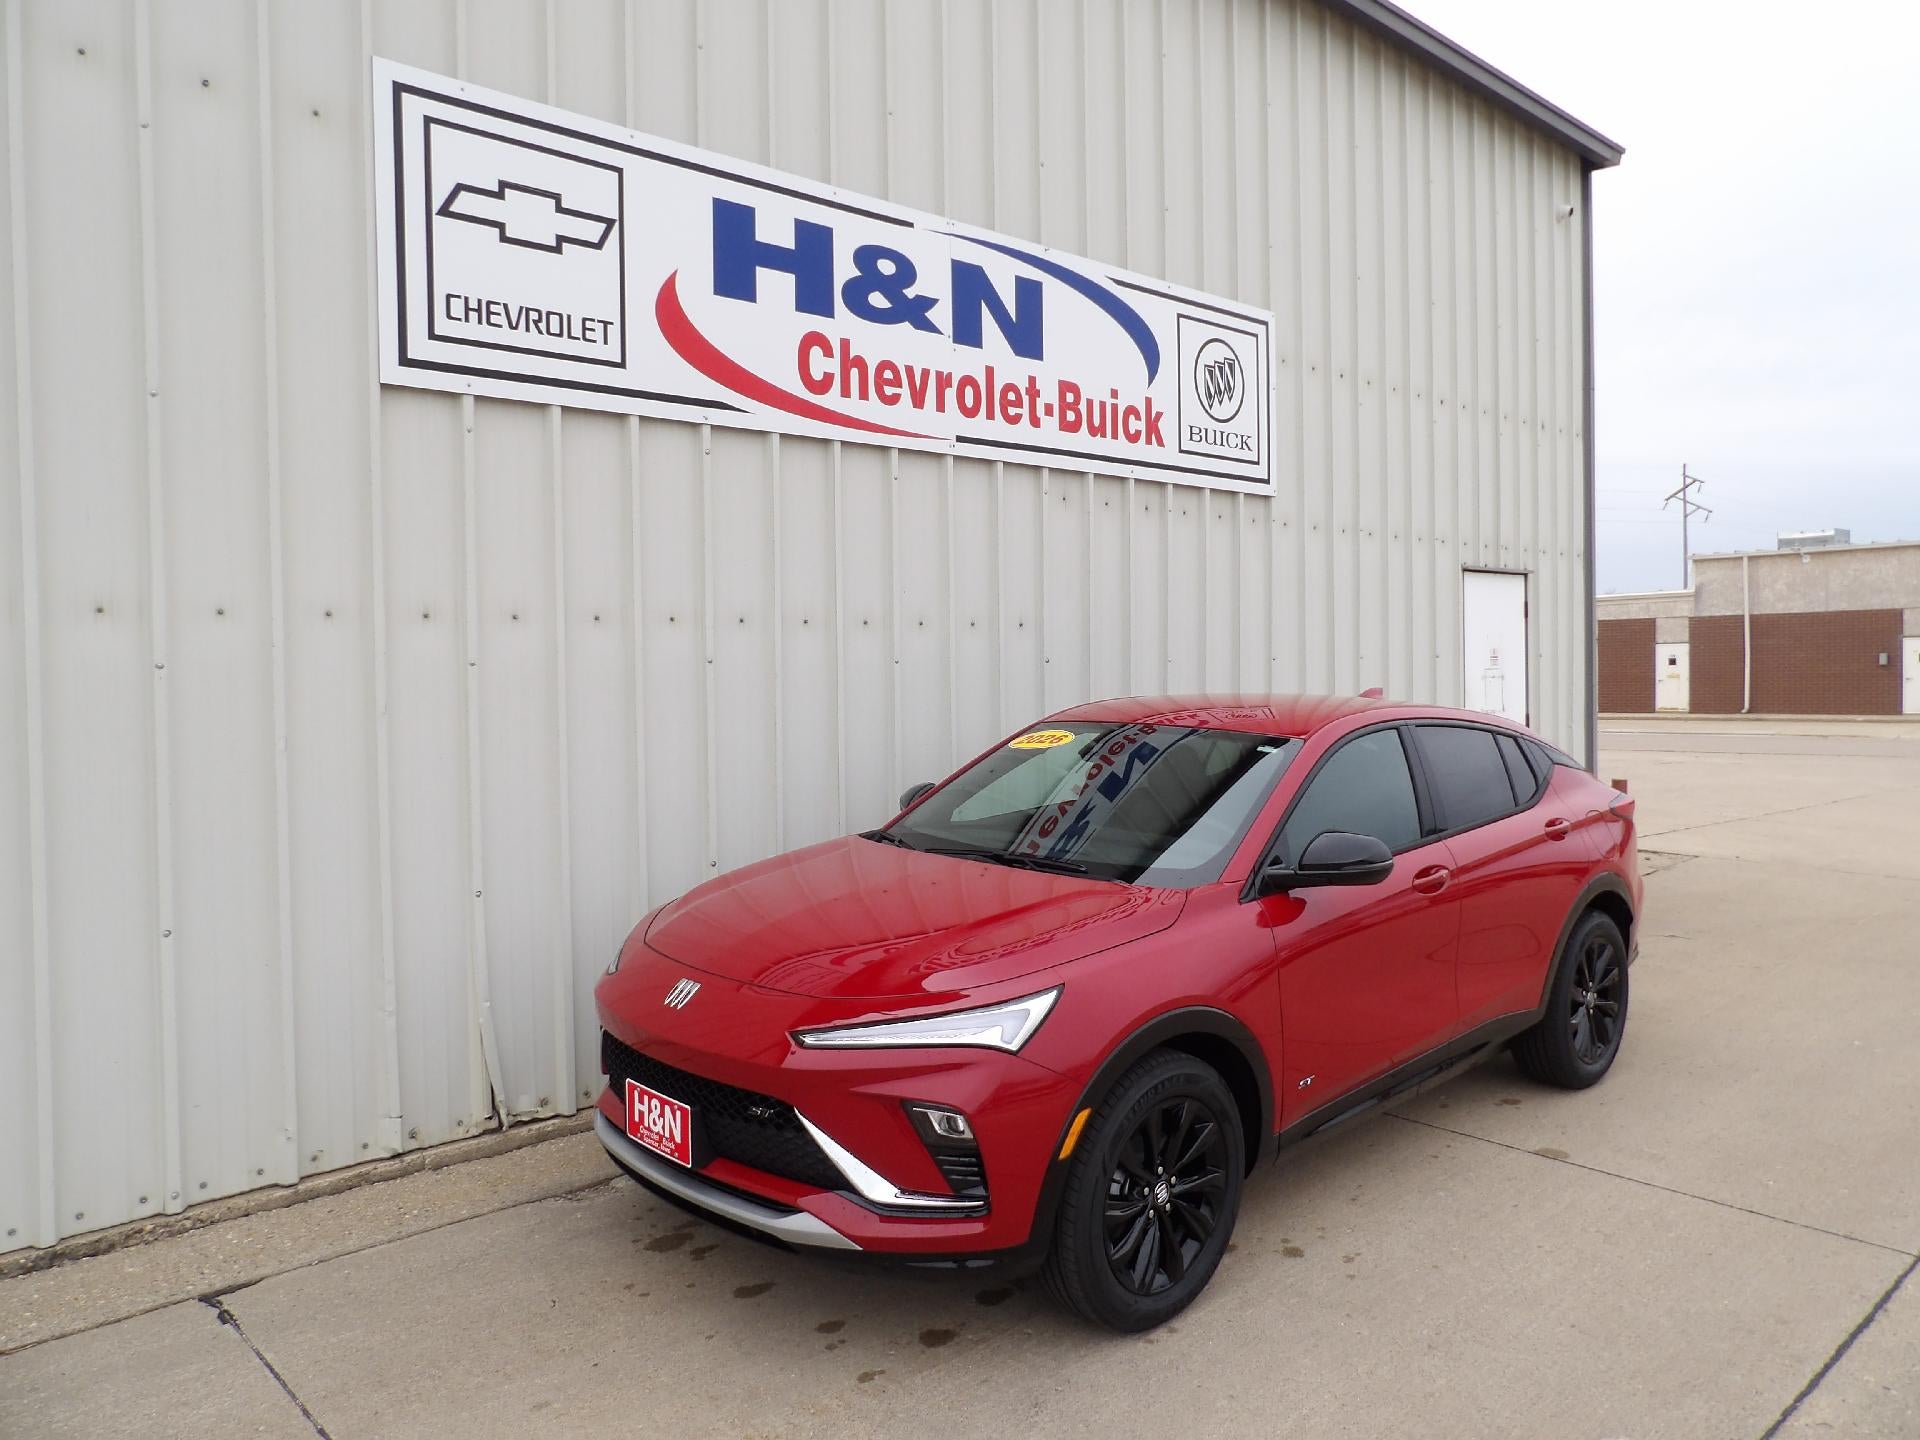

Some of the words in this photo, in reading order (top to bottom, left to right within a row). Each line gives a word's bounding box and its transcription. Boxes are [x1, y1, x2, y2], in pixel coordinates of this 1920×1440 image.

[712, 196, 1044, 362] H&N
[444, 292, 615, 346] CHEVROLET
[797, 330, 1166, 449] Chevrolet-Buick
[1186, 423, 1255, 453] BUICK
[633, 1088, 682, 1144] H&N
